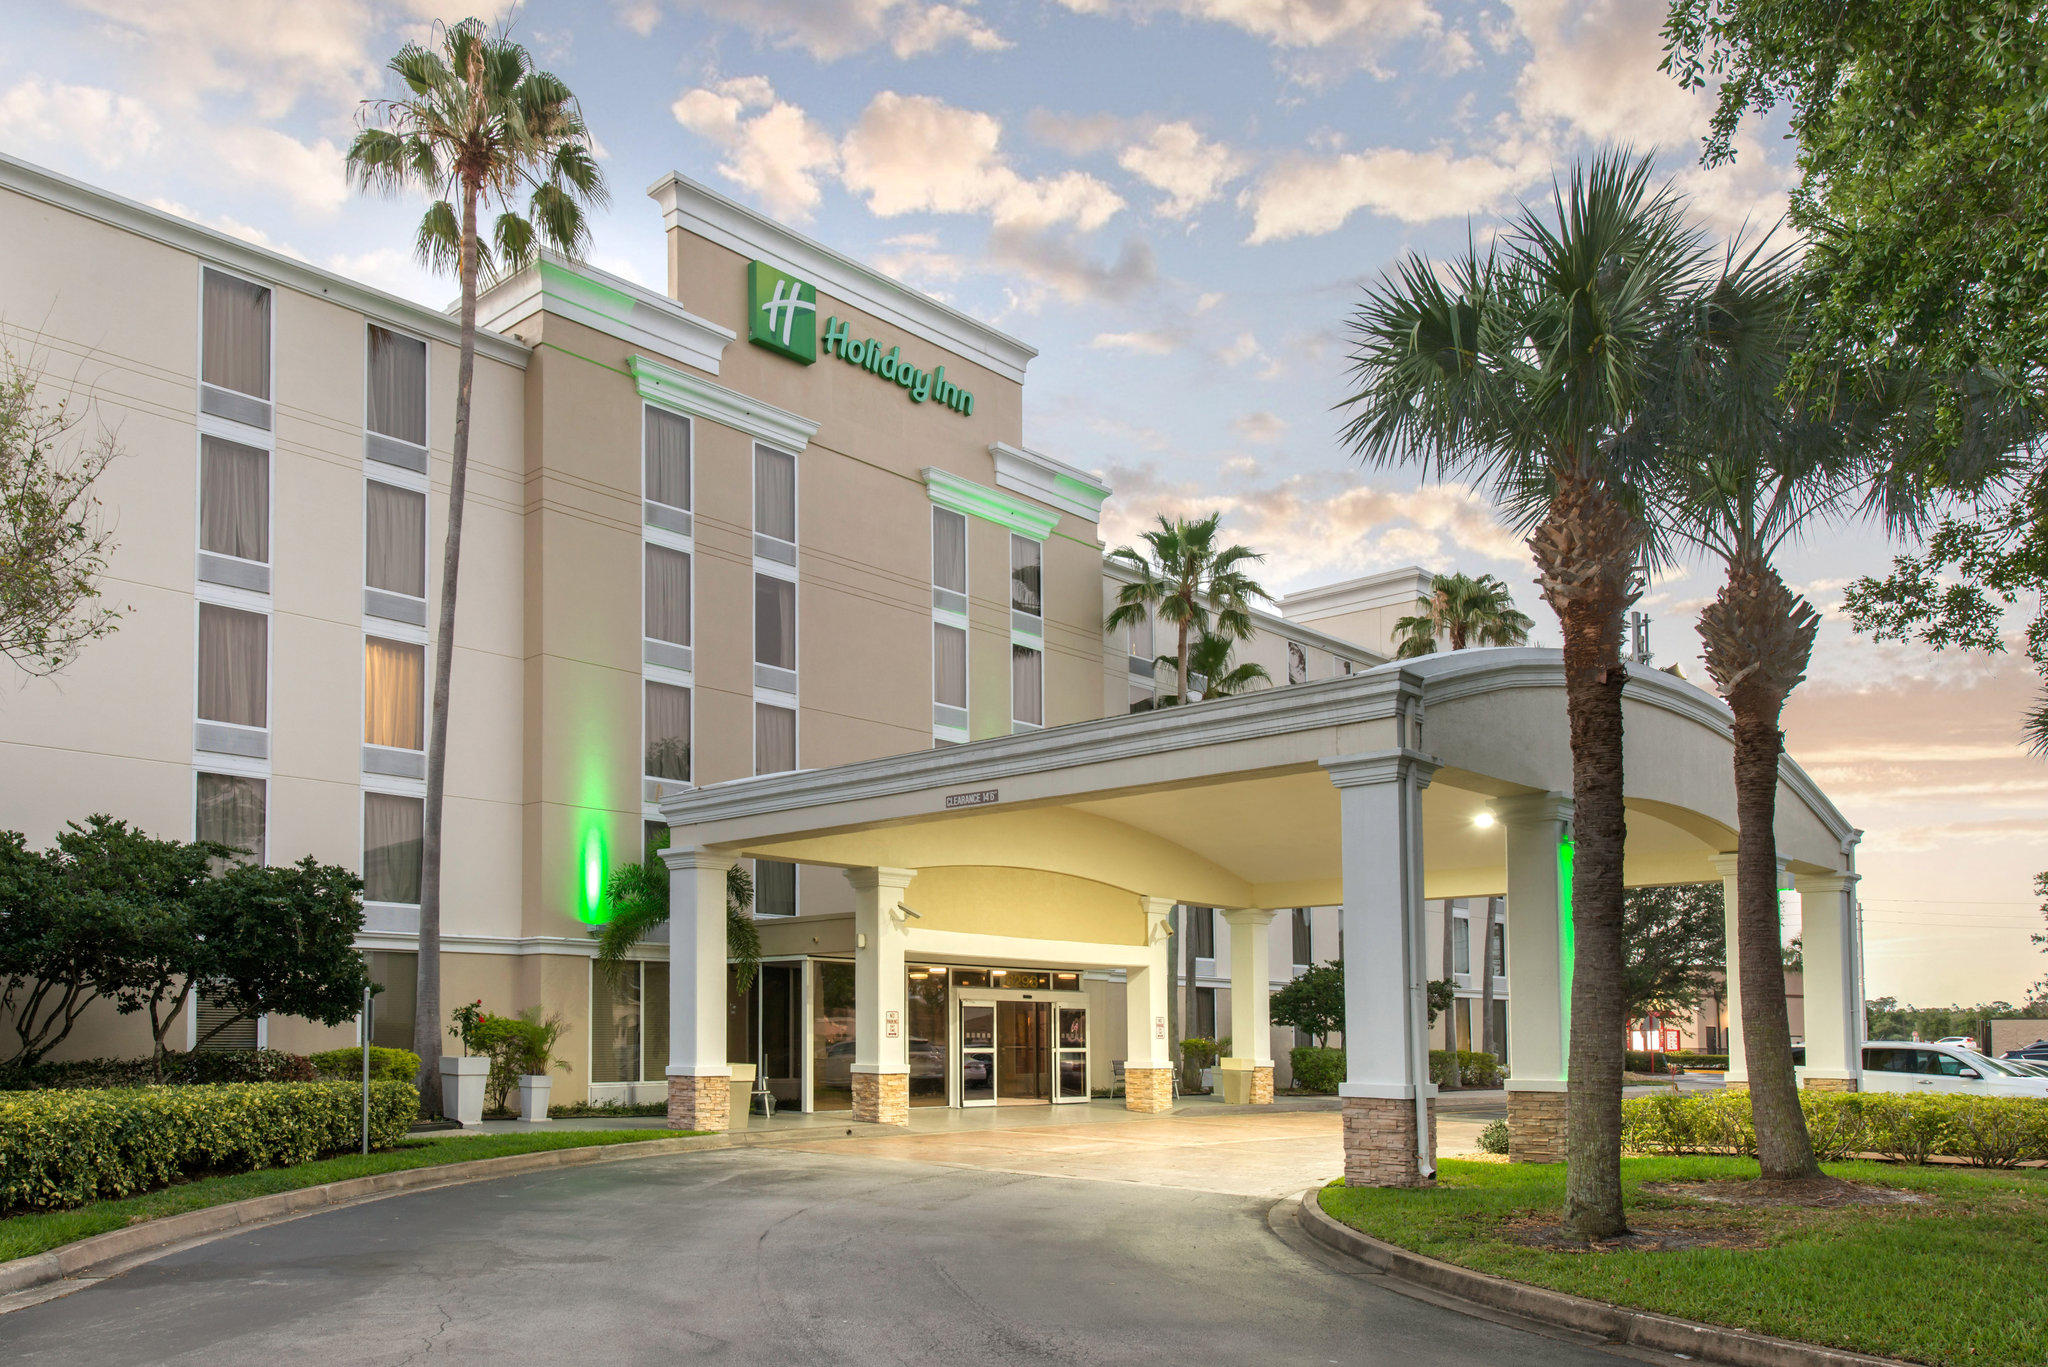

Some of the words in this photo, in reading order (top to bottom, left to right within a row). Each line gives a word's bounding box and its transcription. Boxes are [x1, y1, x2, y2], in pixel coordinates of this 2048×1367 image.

[762, 280, 816, 346] H
[822, 316, 932, 404] Holiday
[931, 366, 975, 417] Inn
[946, 793, 981, 807] CLEARANCE
